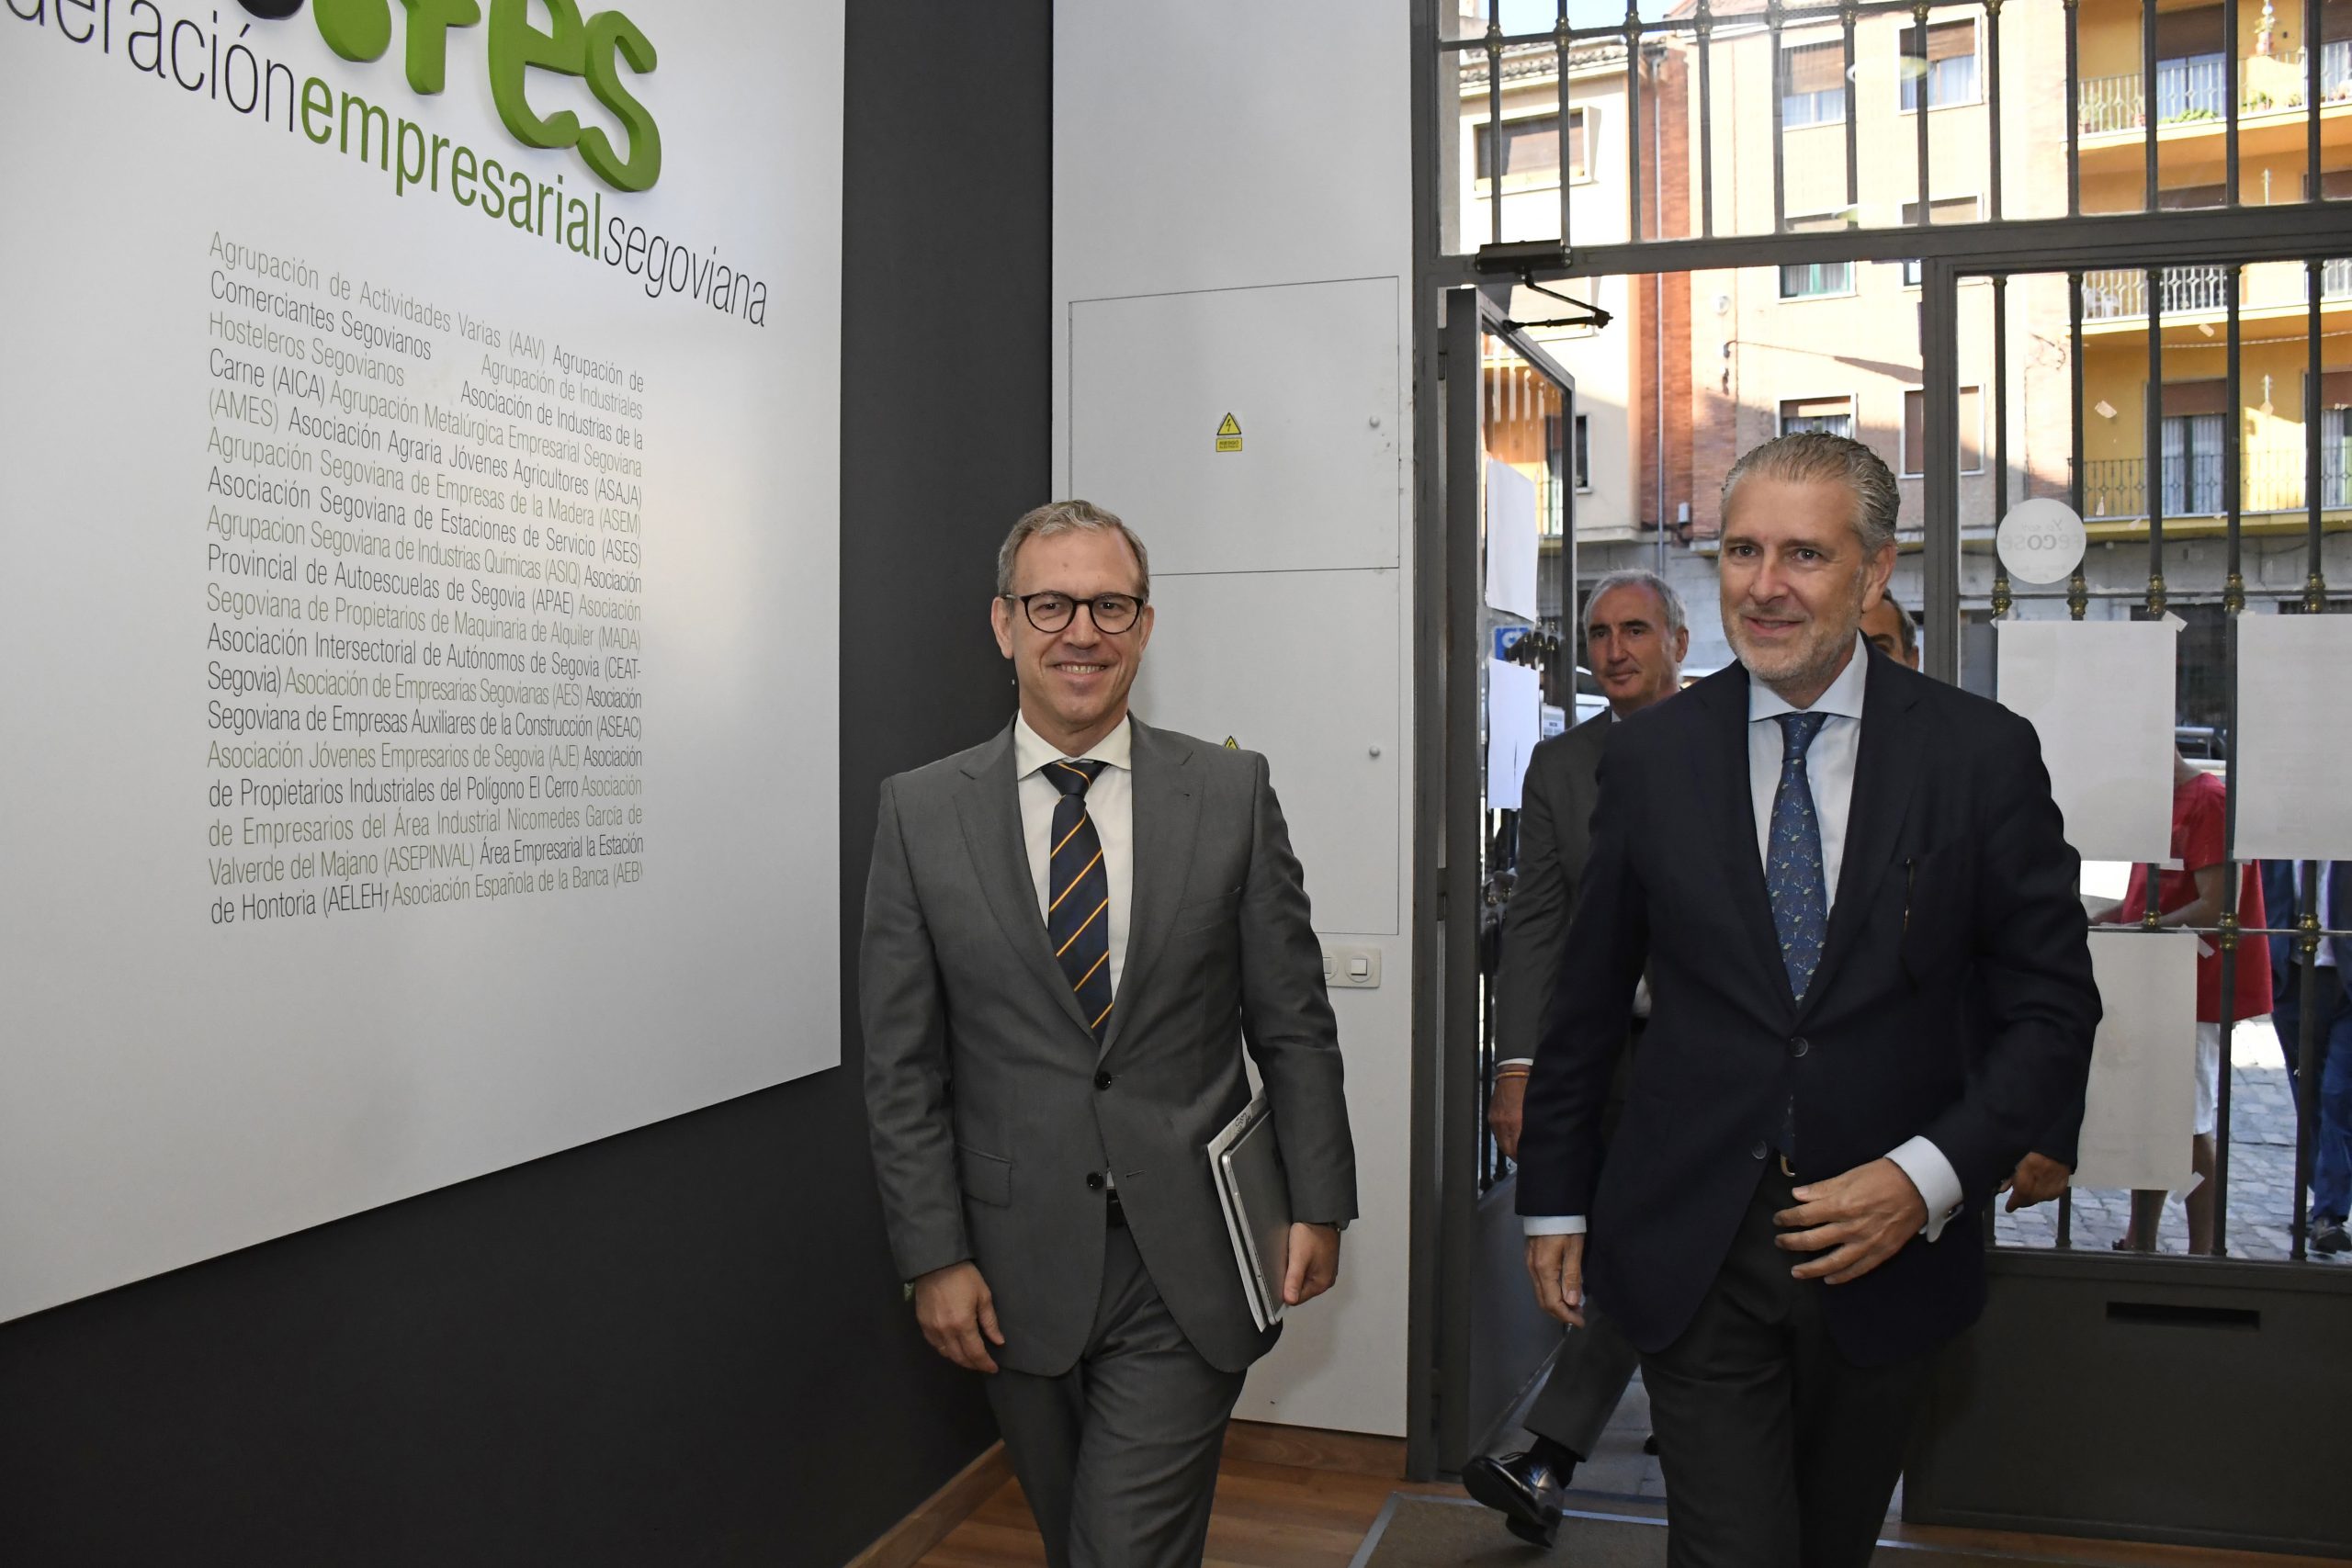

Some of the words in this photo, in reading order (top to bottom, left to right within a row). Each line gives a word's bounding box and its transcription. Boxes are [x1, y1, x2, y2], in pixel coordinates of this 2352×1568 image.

[209, 231, 319, 291] Agrupación
[329, 271, 351, 301] de
[359, 280, 451, 333] Actividades
[458, 310, 501, 349] Varias
[509, 330, 546, 367] (AAV)
[552, 344, 623, 388] Agrupación
[628, 369, 644, 394] de
[209, 310, 306, 361] Hosteleros
[311, 336, 405, 388] Segovianos
[210, 269, 335, 333] Comerciantes
[341, 310, 432, 361] Segovianos
[209, 347, 266, 389] Carne
[272, 364, 325, 409] (AICA)
[329, 378, 419, 425] Agrupación
[424, 401, 504, 447] Metalúrgica
[508, 423, 580, 464] Empresarial
[583, 442, 642, 479] Segoviana
[459, 379, 533, 422] Asociación
[537, 401, 553, 427] de
[557, 405, 613, 443] Industrias
[616, 423, 630, 447] de
[633, 427, 643, 451] la
[481, 353, 555, 396] Agrupación
[559, 377, 575, 402] de
[580, 381, 643, 421] Industriales
[206, 425, 312, 473] Agrupación
[320, 448, 405, 491] Segoviana
[411, 469, 430, 496] de
[435, 472, 505, 511] Empresas
[510, 490, 527, 515] de
[532, 492, 544, 518] la
[548, 496, 594, 527] Madera
[599, 507, 641, 541] (ASEM)
[209, 387, 279, 434] (AMES)
[288, 405, 381, 452] Asociación
[387, 429, 443, 466] Agraria
[448, 443, 508, 479] Jóvenes
[513, 457, 589, 497] Agricultores
[594, 476, 642, 513] (ASAJA)
[207, 465, 311, 510] Asociación
[320, 485, 407, 526] Segoviana
[413, 503, 434, 531] de
[441, 507, 517, 545] Estaciones
[523, 523, 540, 548] de
[545, 526, 596, 558] Servicio
[602, 537, 642, 570] (ASES)
[208, 542, 297, 582] Provincial
[305, 557, 328, 586] de
[334, 560, 440, 600] Autoescuelas
[447, 575, 465, 603] de
[470, 578, 526, 612] Segovia
[531, 587, 574, 620] (APAE)
[578, 592, 641, 622] Asociación
[310, 520, 391, 558] Segoviana
[394, 535, 415, 561] de
[418, 537, 481, 571] Industrias
[484, 547, 541, 581] Químicas
[545, 558, 582, 590] (ASIQ)
[583, 564, 642, 594] Asociación
[206, 581, 302, 621] Segoviana
[307, 593, 329, 623] de
[335, 596, 426, 632] Propietarios
[431, 608, 449, 635] de
[454, 609, 527, 643] Maquinaria
[531, 619, 548, 643] de
[549, 620, 594, 649] Alquiler
[598, 625, 641, 655] (MADA)
[206, 621, 308, 658] Asociación
[315, 631, 416, 665] Intersectorial
[423, 640, 442, 667] de
[446, 642, 526, 673] Autónomos
[530, 649, 547, 675] de
[550, 650, 600, 682] Segovia
[604, 655, 642, 683] (CEAT-
[207, 660, 282, 699] Segovia)
[283, 665, 368, 697] Asociación
[372, 671, 391, 699] de
[394, 672, 478, 705] Empresarias
[480, 677, 549, 709] Segovianas
[552, 682, 583, 711] (AES)
[584, 683, 642, 710] Asociación
[207, 699, 301, 737] Segoviana
[305, 704, 327, 732] de
[332, 704, 409, 739] Empresas
[410, 707, 477, 736] Auxiliares
[480, 710, 498, 736] de
[501, 711, 513, 736] la
[514, 711, 594, 738] Construcción
[595, 715, 642, 743] (ASEAC)
[206, 739, 304, 769] Asociación
[308, 739, 377, 769] Jóvenes
[381, 741, 469, 773] Empresarios
[472, 742, 491, 768] de
[493, 742, 546, 773] Segovia
[548, 743, 580, 773] (AJE)
[582, 744, 643, 768] Asociación
[208, 778, 233, 808] de
[240, 777, 344, 813] Propietarios
[349, 776, 435, 804] Industriales
[439, 775, 461, 802] del
[467, 774, 526, 806] Polígono
[529, 775, 541, 799] El
[545, 774, 579, 799] Cerro
[581, 773, 642, 797] Asociación
[208, 818, 233, 848] de
[243, 814, 354, 850] Empresarios
[361, 812, 386, 840] del
[393, 806, 431, 838] Área
[437, 807, 501, 835] Industrial
[507, 806, 581, 831] Nicomedes
[585, 804, 623, 828] García
[628, 803, 643, 826] de
[208, 853, 285, 886] Valverde
[289, 852, 315, 881] del
[320, 849, 379, 883] Majano
[383, 841, 475, 879] (ASEPINVAL)
[479, 835, 511, 866] Área
[514, 835, 583, 867] Empresarial
[585, 834, 597, 858] la
[598, 830, 644, 857] Estación
[210, 895, 235, 925] de
[242, 888, 317, 922] Hontoria
[391, 874, 470, 908] Asociación
[474, 870, 535, 902] Española
[537, 868, 555, 893] de
[558, 867, 569, 890] la
[572, 865, 609, 889] Banca
